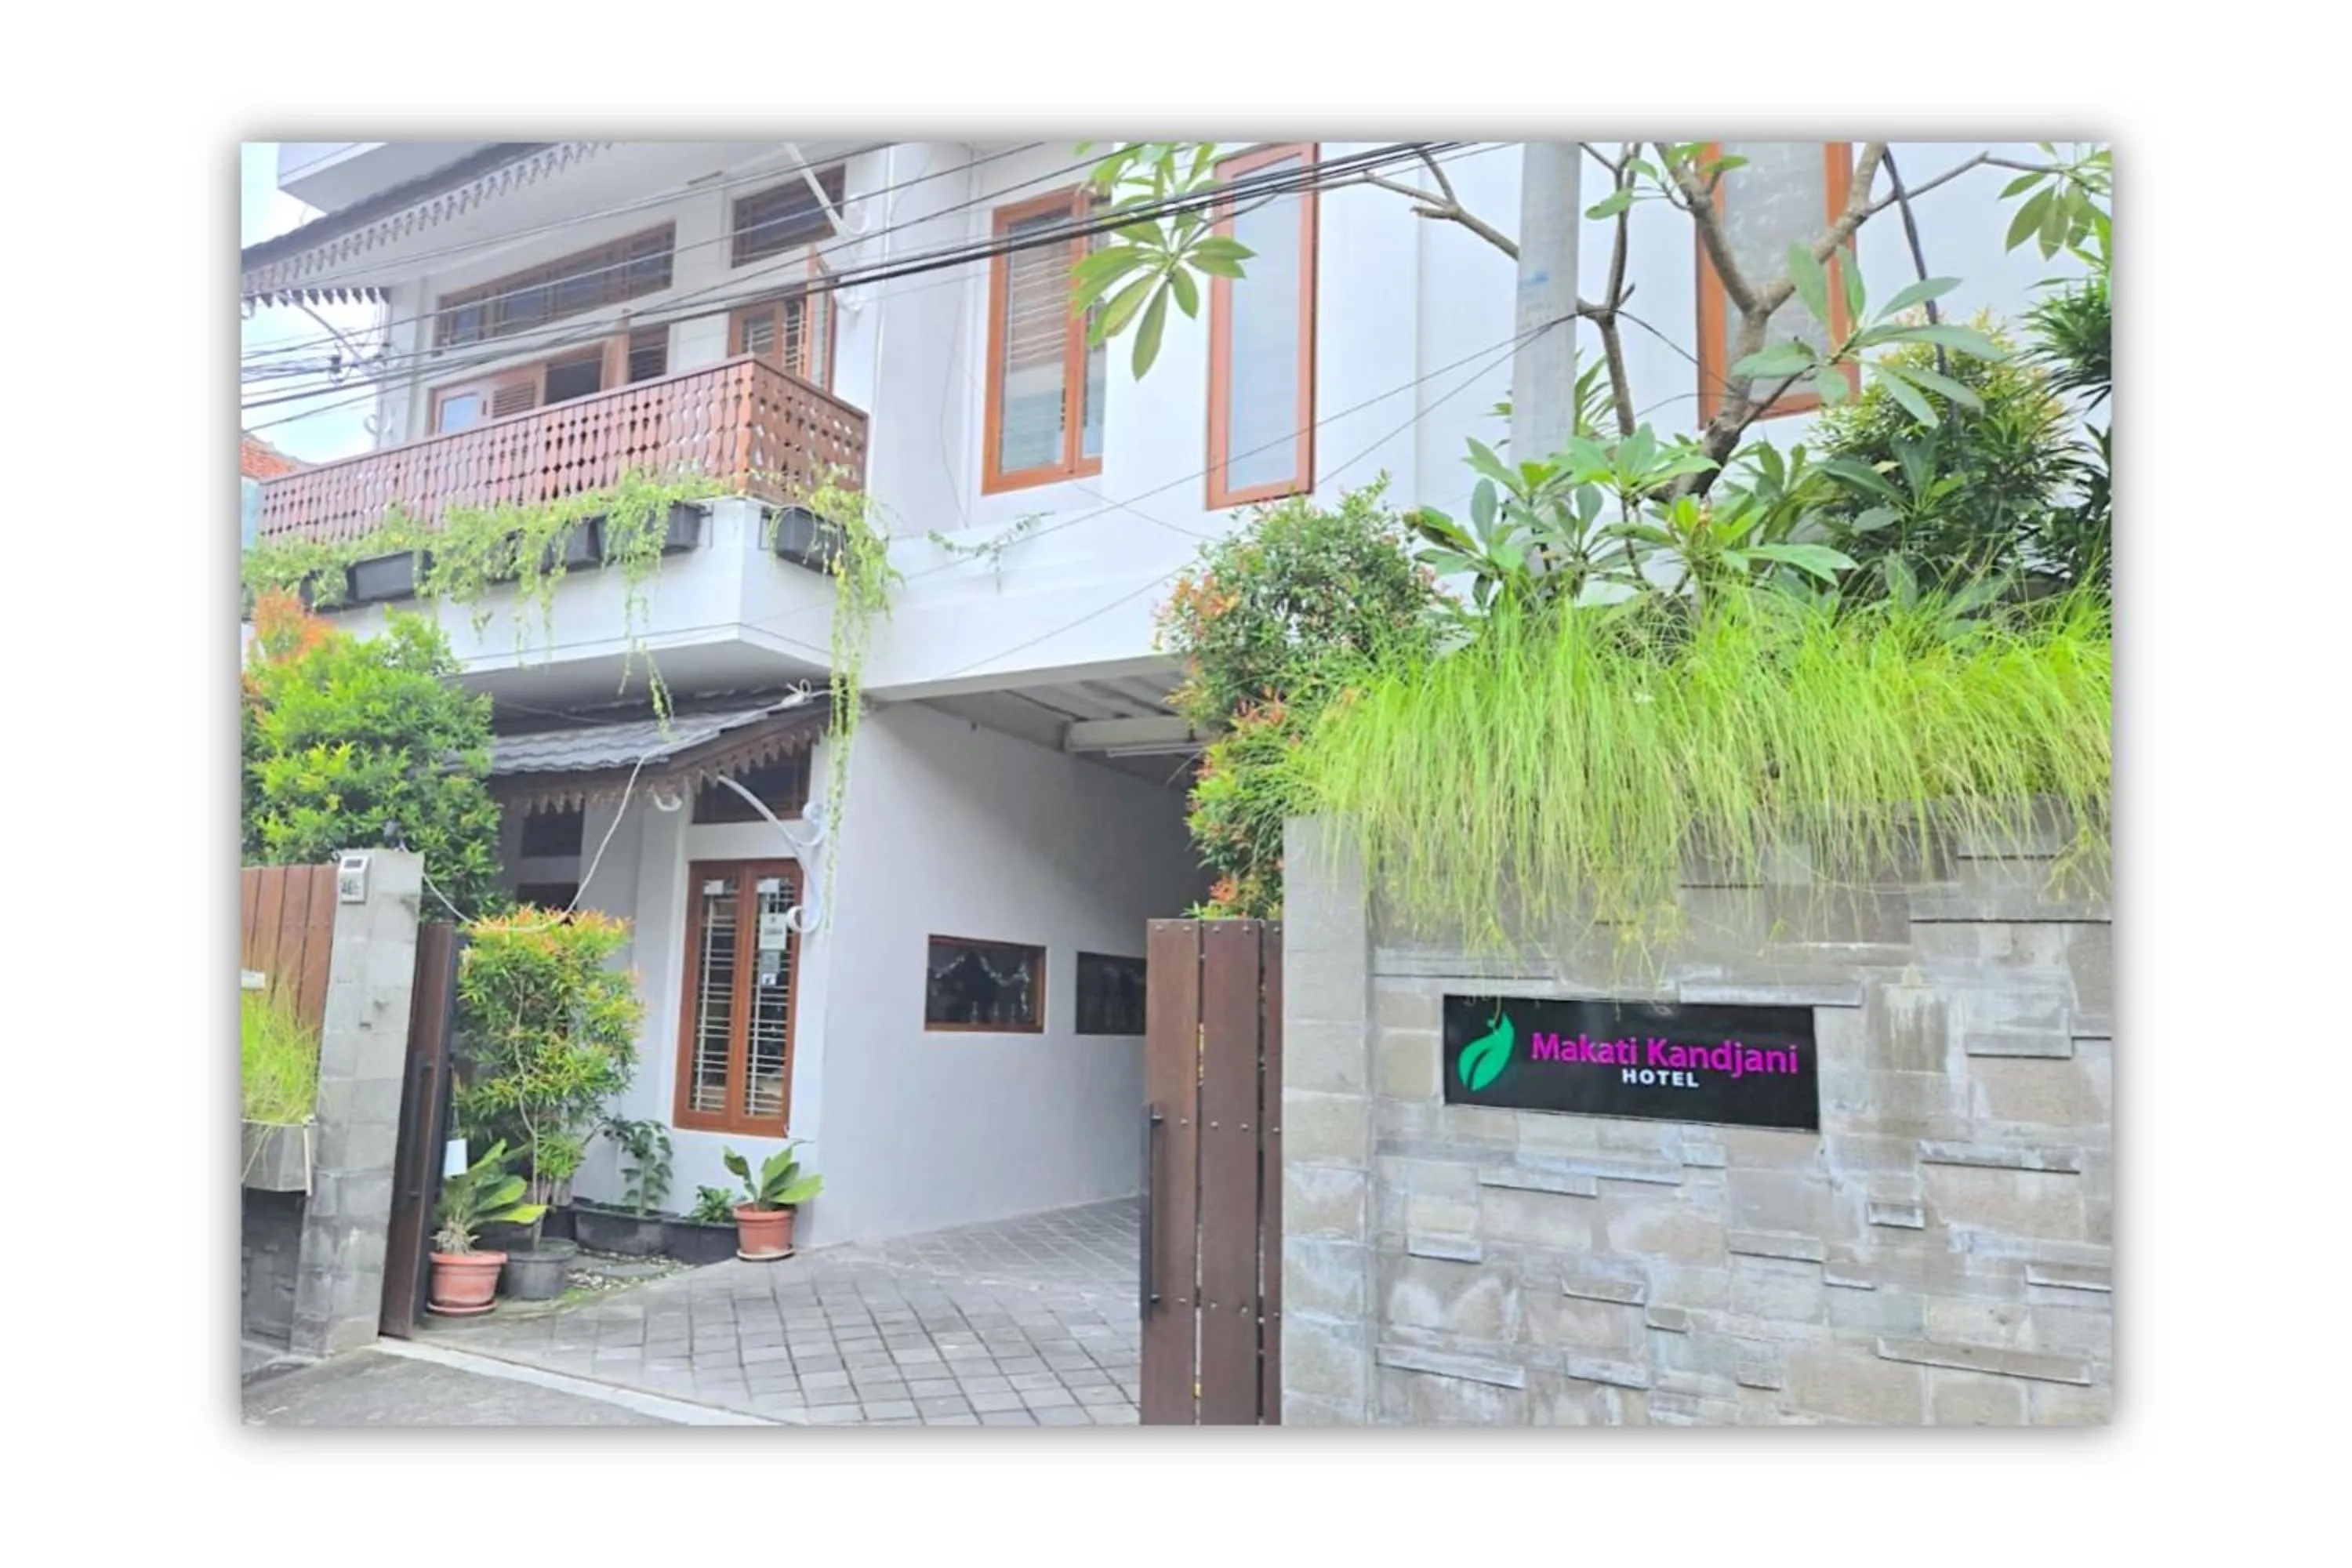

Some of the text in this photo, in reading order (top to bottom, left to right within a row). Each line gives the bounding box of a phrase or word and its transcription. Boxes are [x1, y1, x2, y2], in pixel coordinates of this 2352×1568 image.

[1530, 1032, 1798, 1079] Makati Kandjani
[1621, 1068, 1699, 1087] HOTEL
